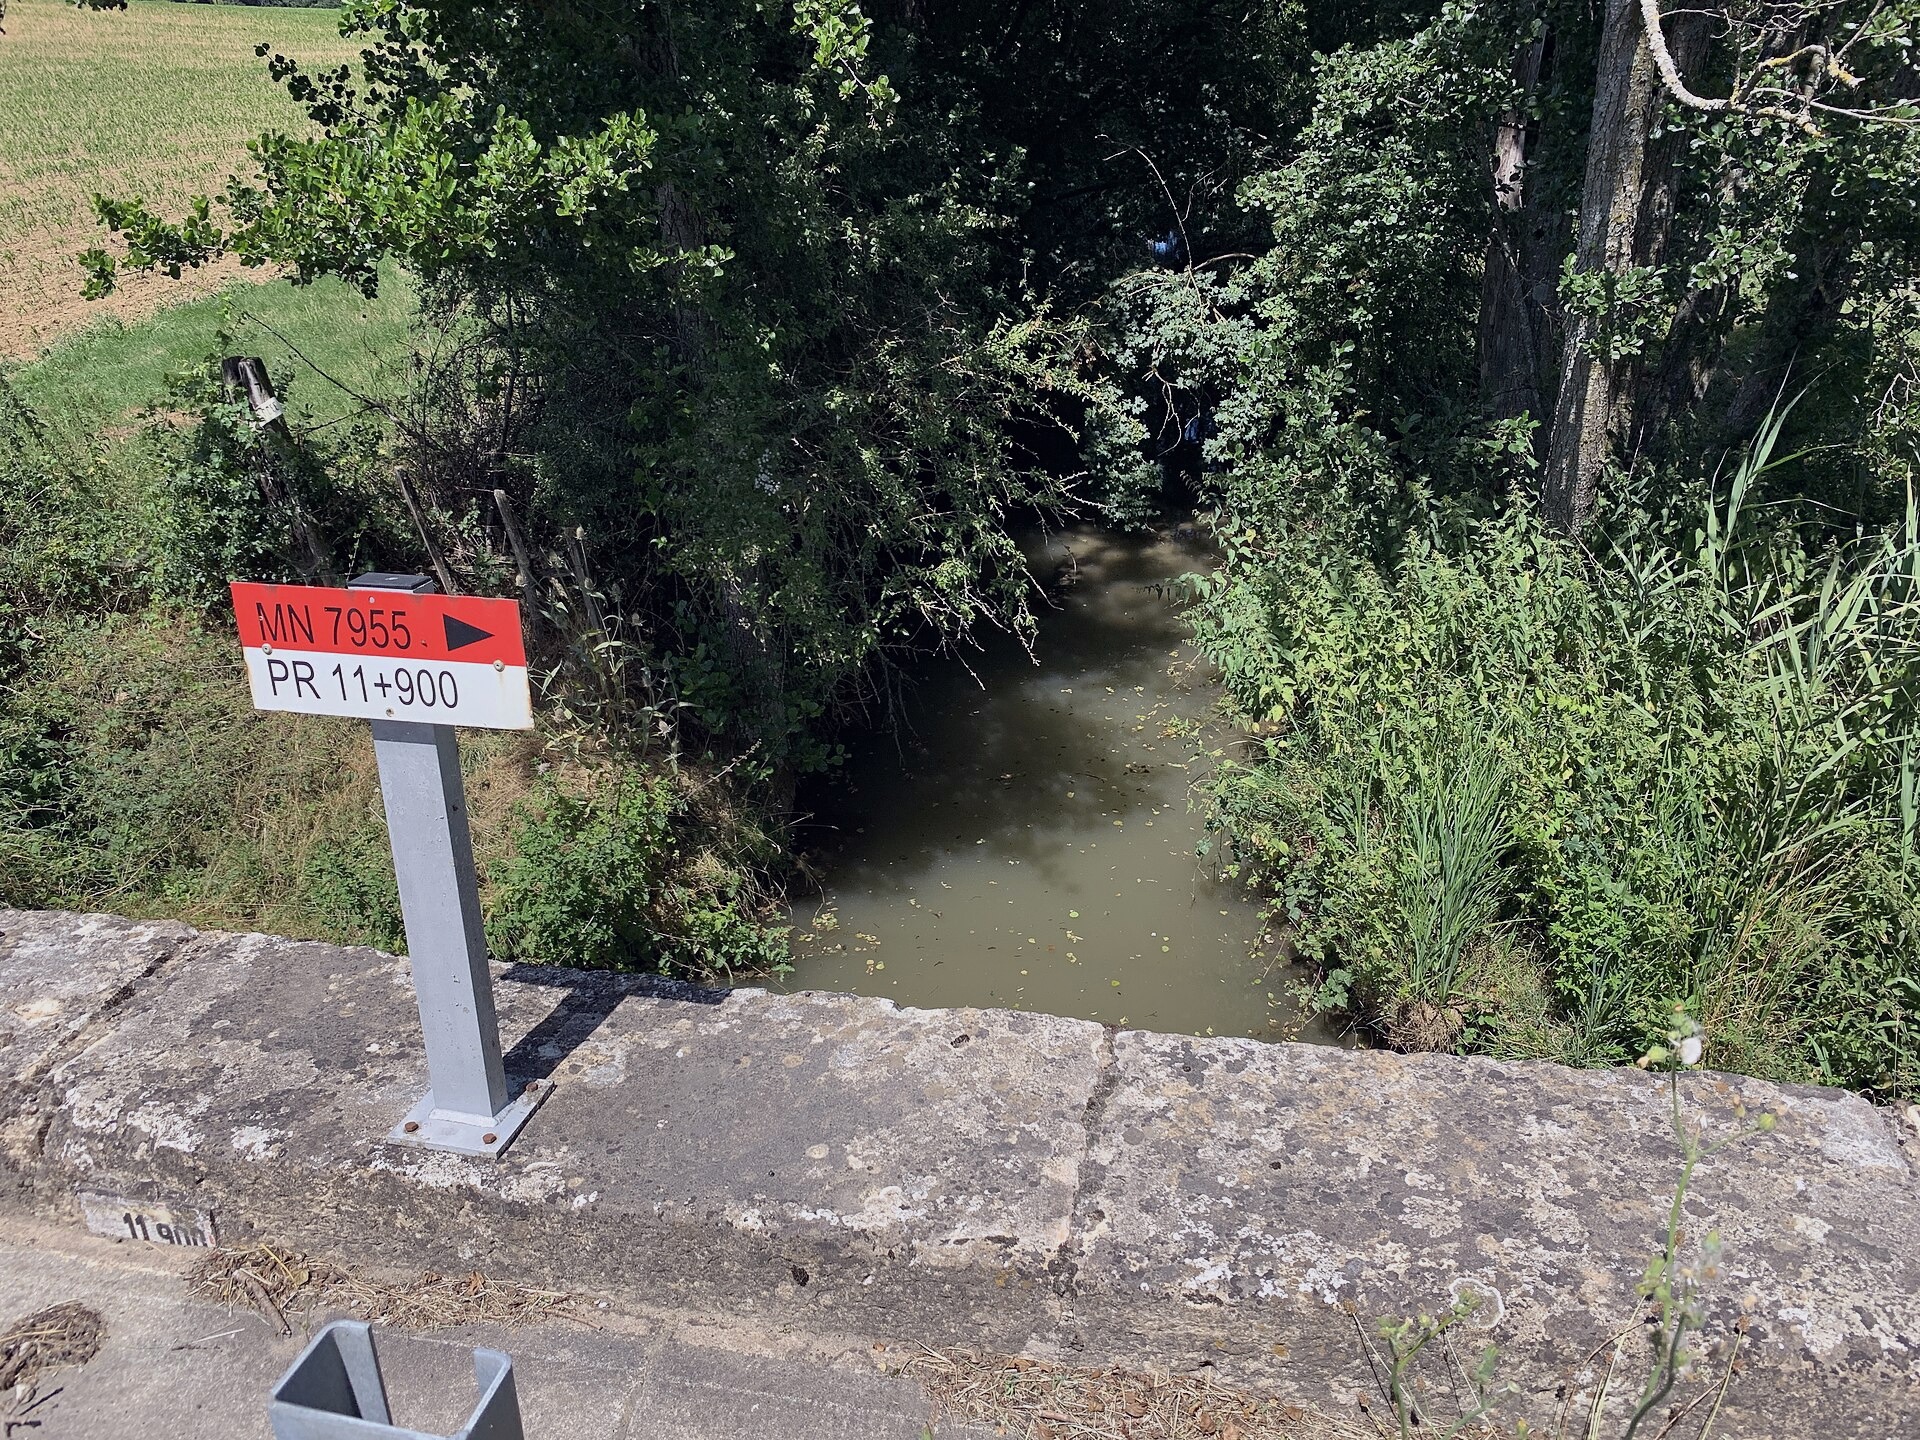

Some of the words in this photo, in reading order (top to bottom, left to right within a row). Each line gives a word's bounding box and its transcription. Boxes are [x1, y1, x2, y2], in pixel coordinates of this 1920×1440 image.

[256, 602, 315, 644] MN
[324, 607, 411, 650] 7955
[267, 659, 321, 699] PR
[332, 663, 458, 709] 11+900
[123, 1212, 150, 1241] 11
